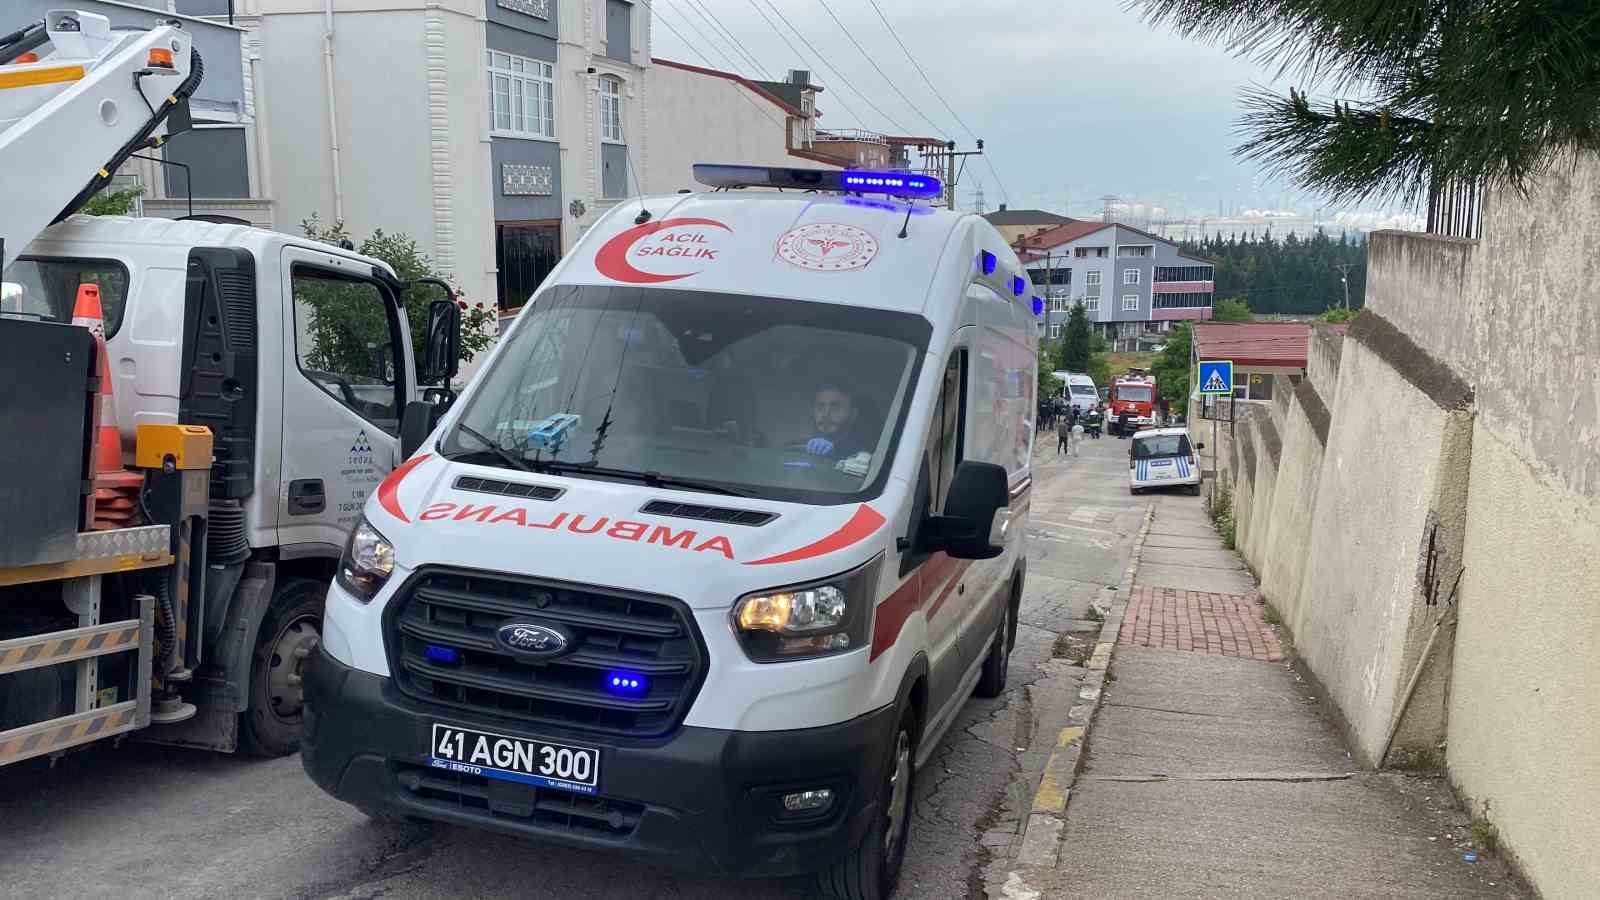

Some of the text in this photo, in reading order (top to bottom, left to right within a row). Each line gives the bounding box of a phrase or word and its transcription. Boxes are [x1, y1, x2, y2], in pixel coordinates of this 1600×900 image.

[509, 628, 549, 648] Ford
[438, 730, 591, 780] 41 AGN 300
